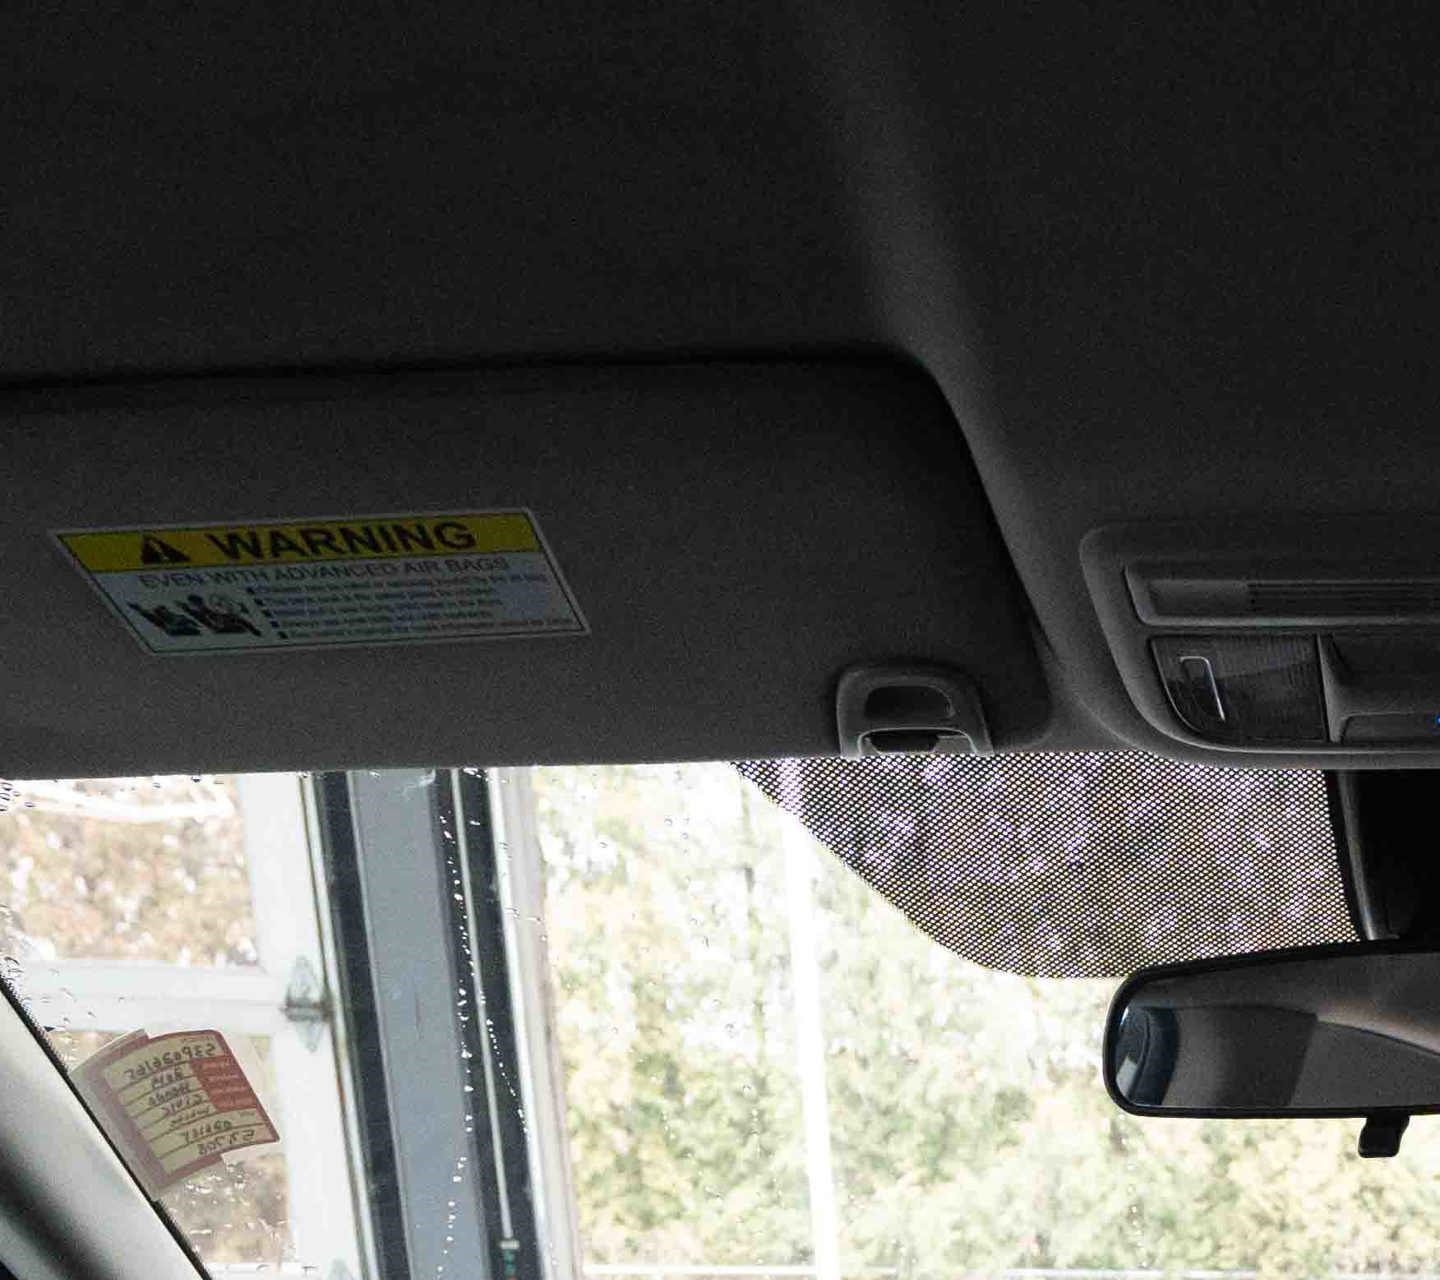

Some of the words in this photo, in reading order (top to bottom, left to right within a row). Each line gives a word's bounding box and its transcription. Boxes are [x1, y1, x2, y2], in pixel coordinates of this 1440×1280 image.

[205, 521, 476, 560] WARNING
[137, 571, 205, 588] EVEN
[208, 567, 271, 585] WITH
[274, 561, 400, 581] ADVANCED
[403, 559, 440, 576] AIR
[444, 557, 509, 573] BAGS
